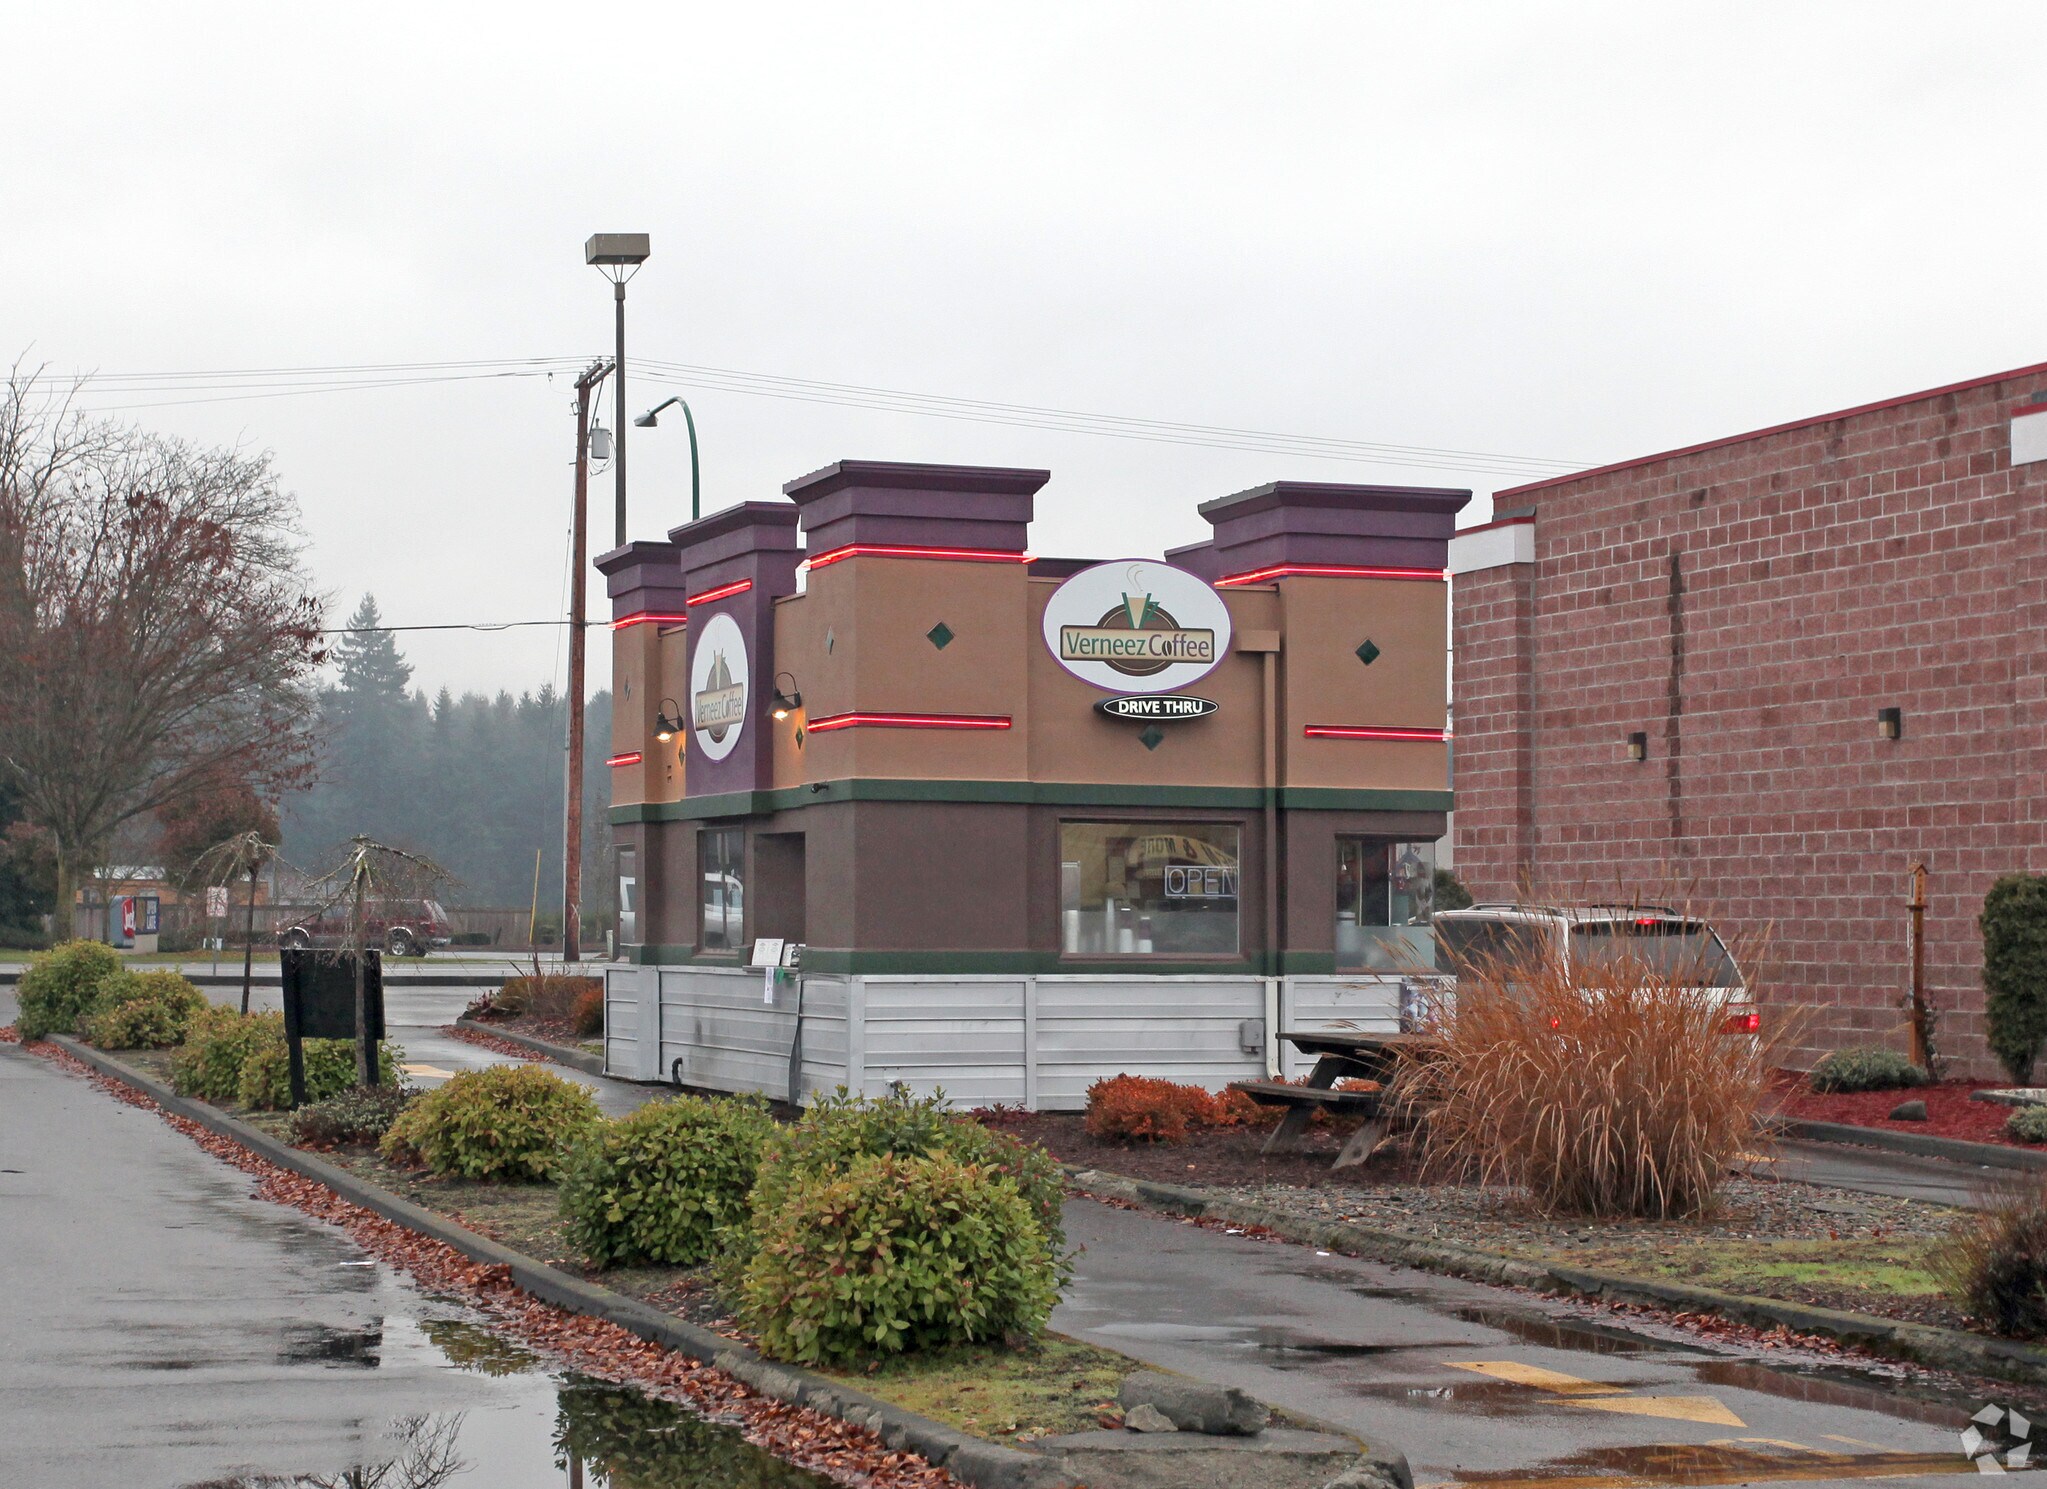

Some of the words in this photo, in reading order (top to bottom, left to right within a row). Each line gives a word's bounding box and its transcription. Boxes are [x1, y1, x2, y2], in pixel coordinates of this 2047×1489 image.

[1065, 632, 1147, 656] Verneez
[1148, 633, 1210, 658] Coffee
[696, 697, 721, 724] Verneez
[721, 691, 742, 718] Coffee
[1118, 700, 1160, 714] DRIVE
[1162, 701, 1203, 714] THRU
[1168, 868, 1237, 894] OPEN
